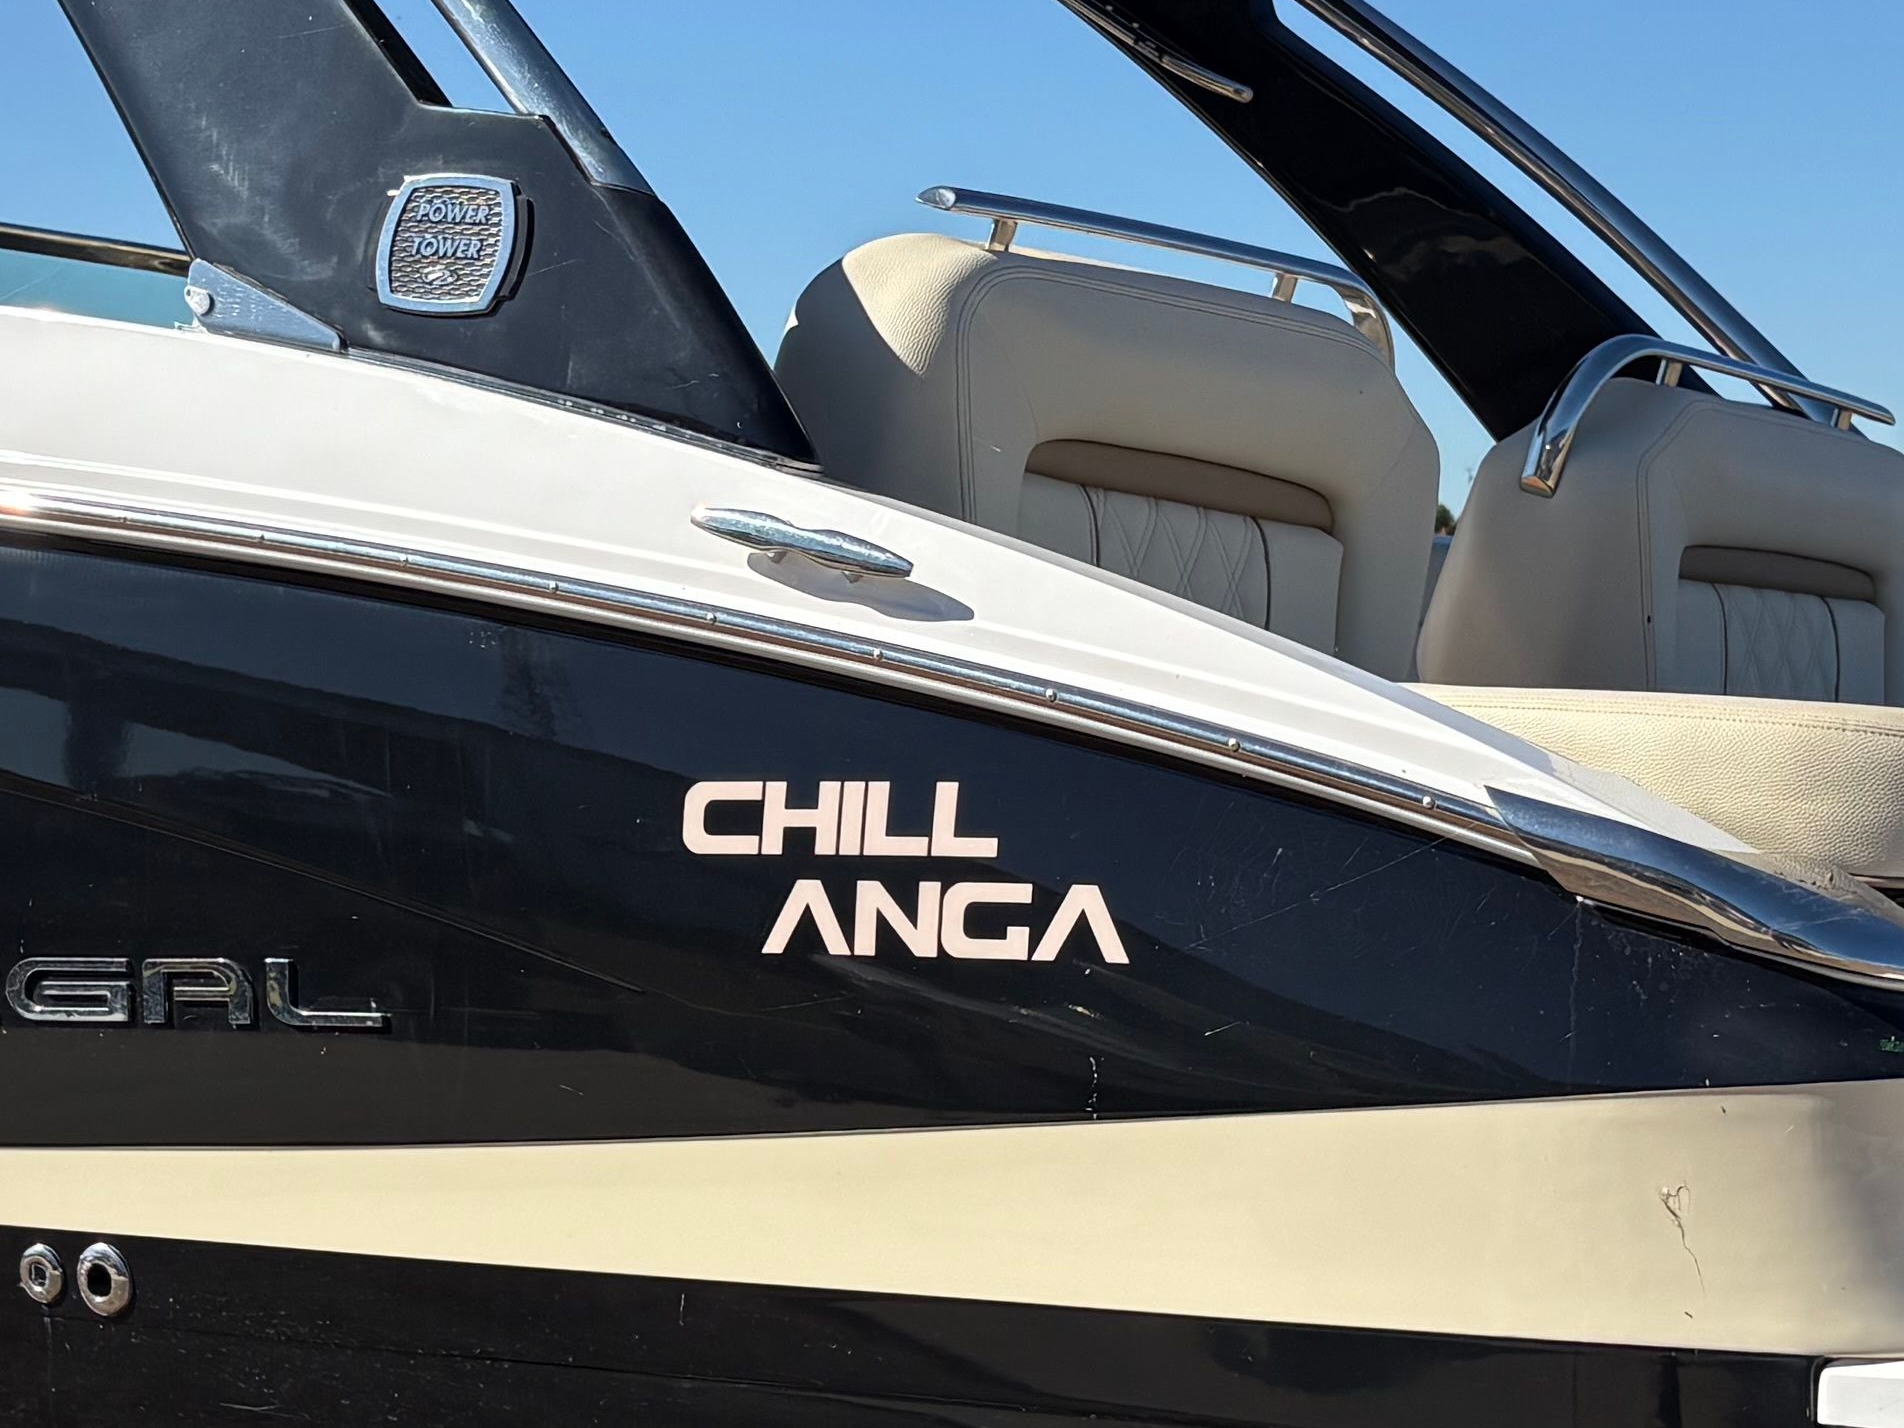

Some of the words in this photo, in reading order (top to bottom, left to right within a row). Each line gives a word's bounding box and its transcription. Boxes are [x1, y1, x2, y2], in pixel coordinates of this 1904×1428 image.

[416, 202, 490, 223] POWER
[412, 236, 482, 258] TOWER
[682, 781, 998, 857] CHILL
[762, 879, 1130, 964] ANGA
